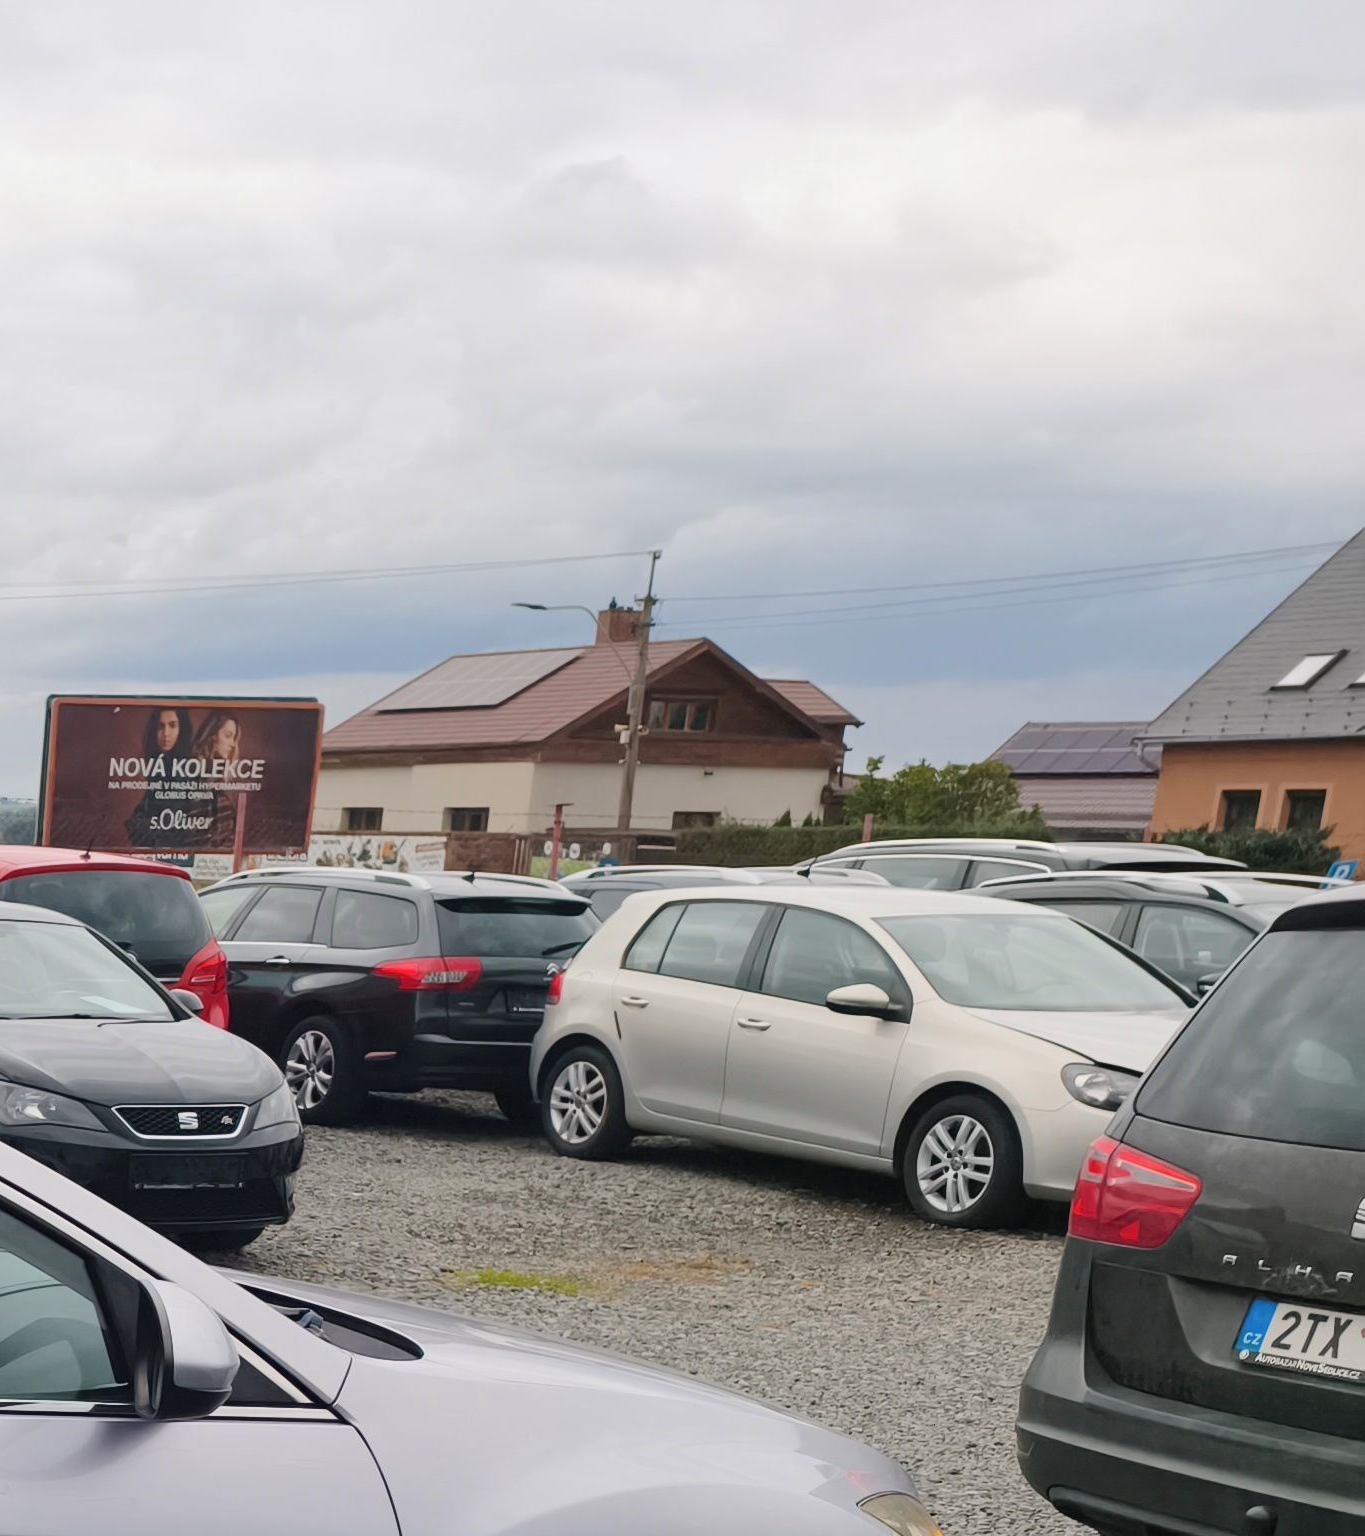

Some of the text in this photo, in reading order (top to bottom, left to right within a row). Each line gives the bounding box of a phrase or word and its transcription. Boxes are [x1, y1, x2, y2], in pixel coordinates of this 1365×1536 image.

[109, 753, 266, 779] NOVÁ KOLEKCE
[108, 781, 120, 790] NA
[163, 781, 170, 790] V
[199, 782, 262, 791] HYPERMARKETU
[155, 791, 187, 799] GLOBUS
[150, 808, 214, 830] s.Oliver
[1243, 1332, 1263, 1345] CZ
[1270, 1310, 1354, 1359] 2TX
